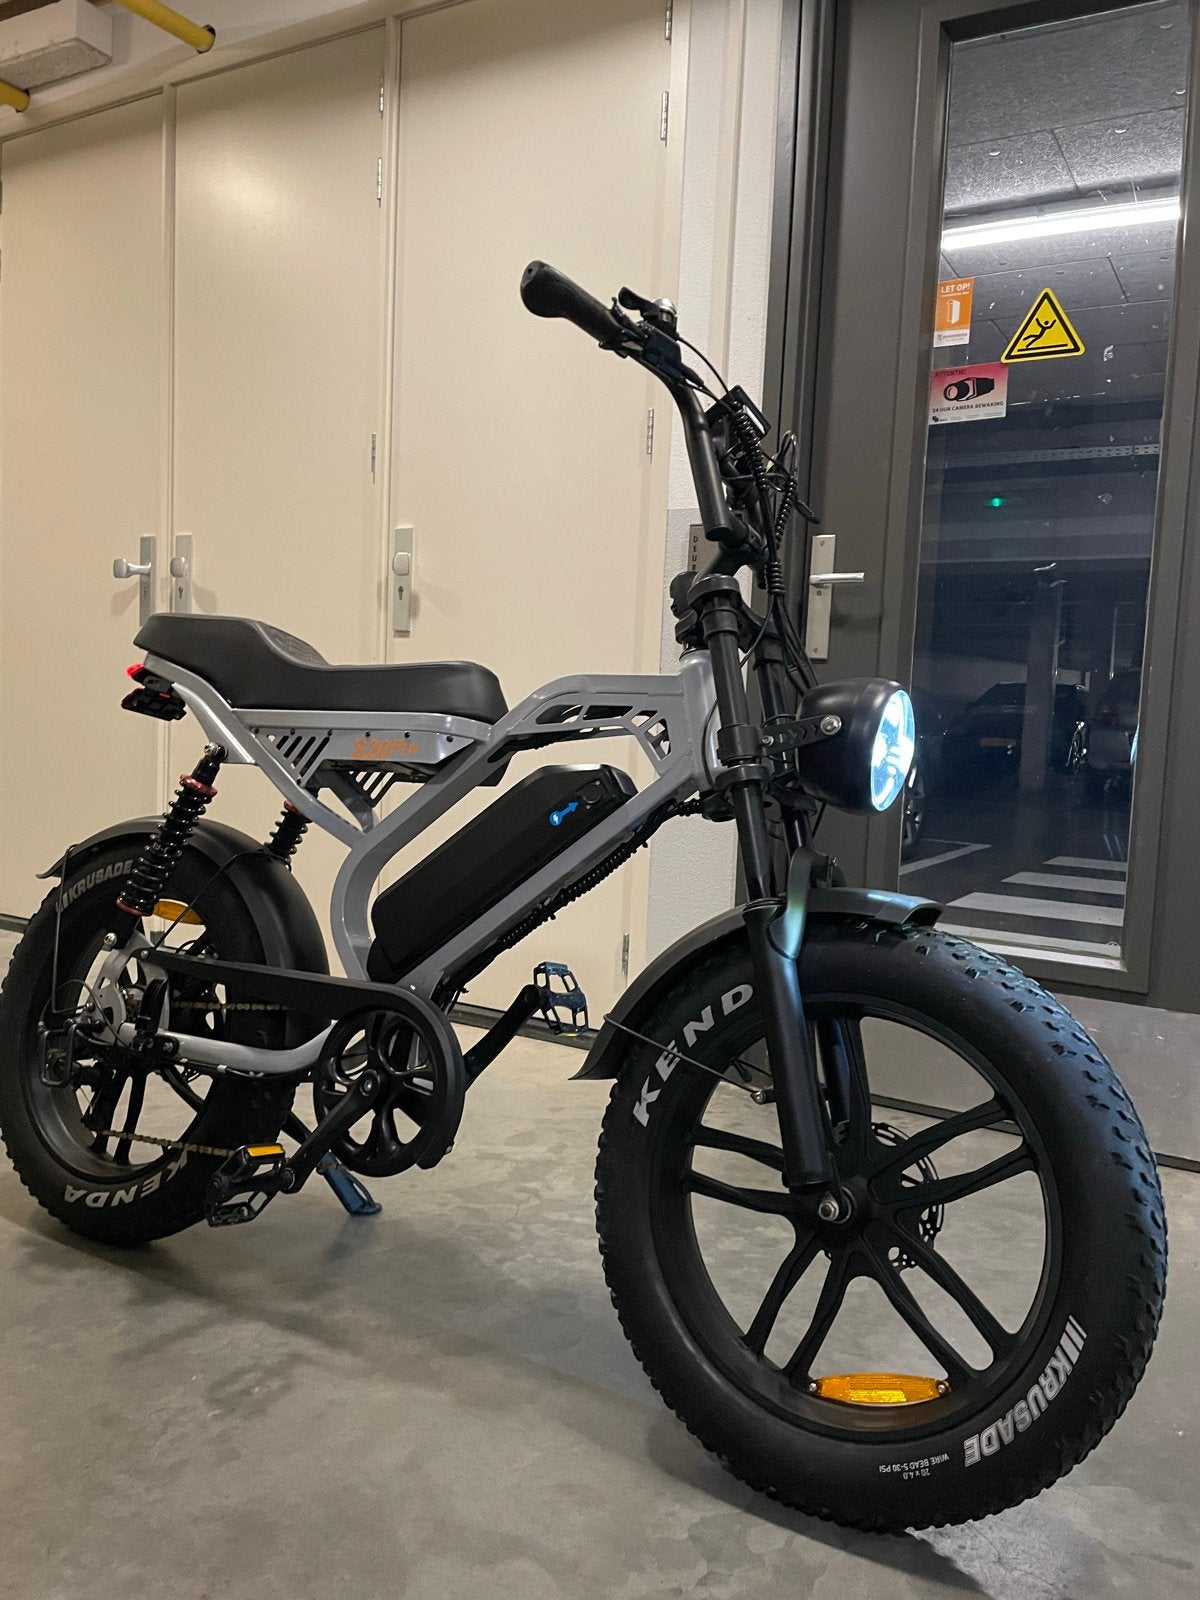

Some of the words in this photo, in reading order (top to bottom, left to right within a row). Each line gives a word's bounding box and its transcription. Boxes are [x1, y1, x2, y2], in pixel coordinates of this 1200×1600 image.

[941, 285, 955, 293] LET
[957, 282, 970, 292] OP!
[68, 859, 134, 903] KRUSADE
[632, 983, 754, 1128] KEND
[64, 1148, 188, 1208] KENDA
[963, 1345, 1073, 1468] KRUSADE
[909, 1458, 930, 1470] BEAD
[930, 1453, 950, 1466] WIRE
[879, 1464, 892, 1473] PSI
[892, 1463, 909, 1472] 5-30
[920, 1468, 931, 1477] 20
[902, 1471, 914, 1480] 4.0
